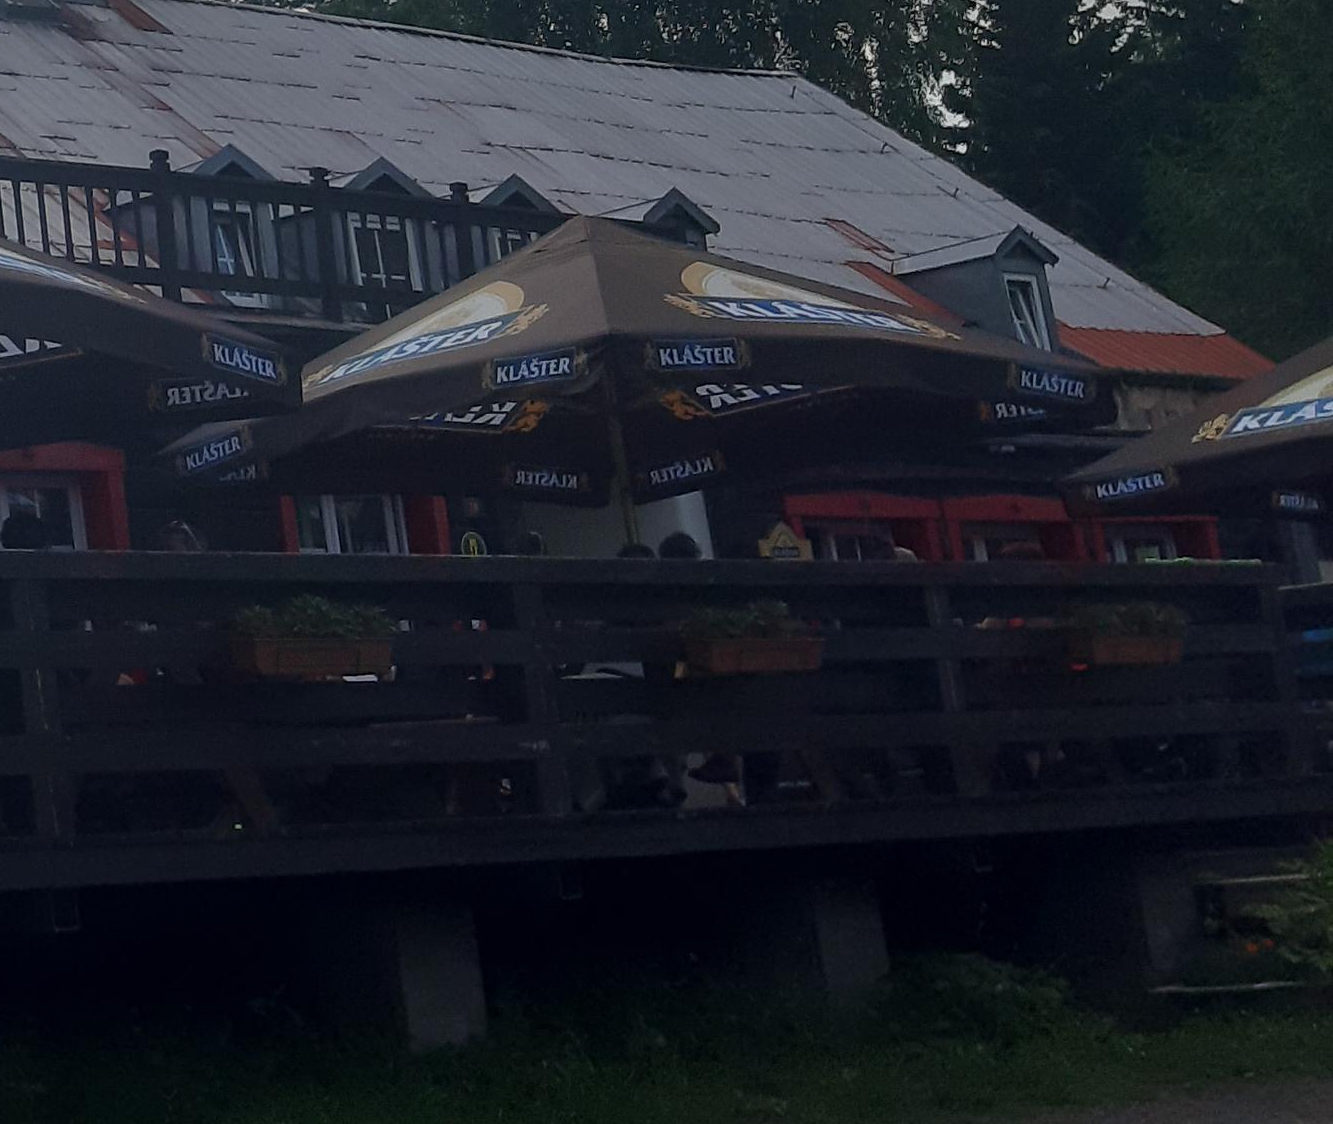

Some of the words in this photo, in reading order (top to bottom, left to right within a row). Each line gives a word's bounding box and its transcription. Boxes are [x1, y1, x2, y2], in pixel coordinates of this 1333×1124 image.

[213, 343, 277, 379] KLÁŠTER
[659, 344, 736, 367] KLÁŠTER
[496, 356, 571, 383] KLÁŠTER
[1021, 371, 1084, 398] KLÁŠTER
[186, 436, 242, 469] KLÁŠTER
